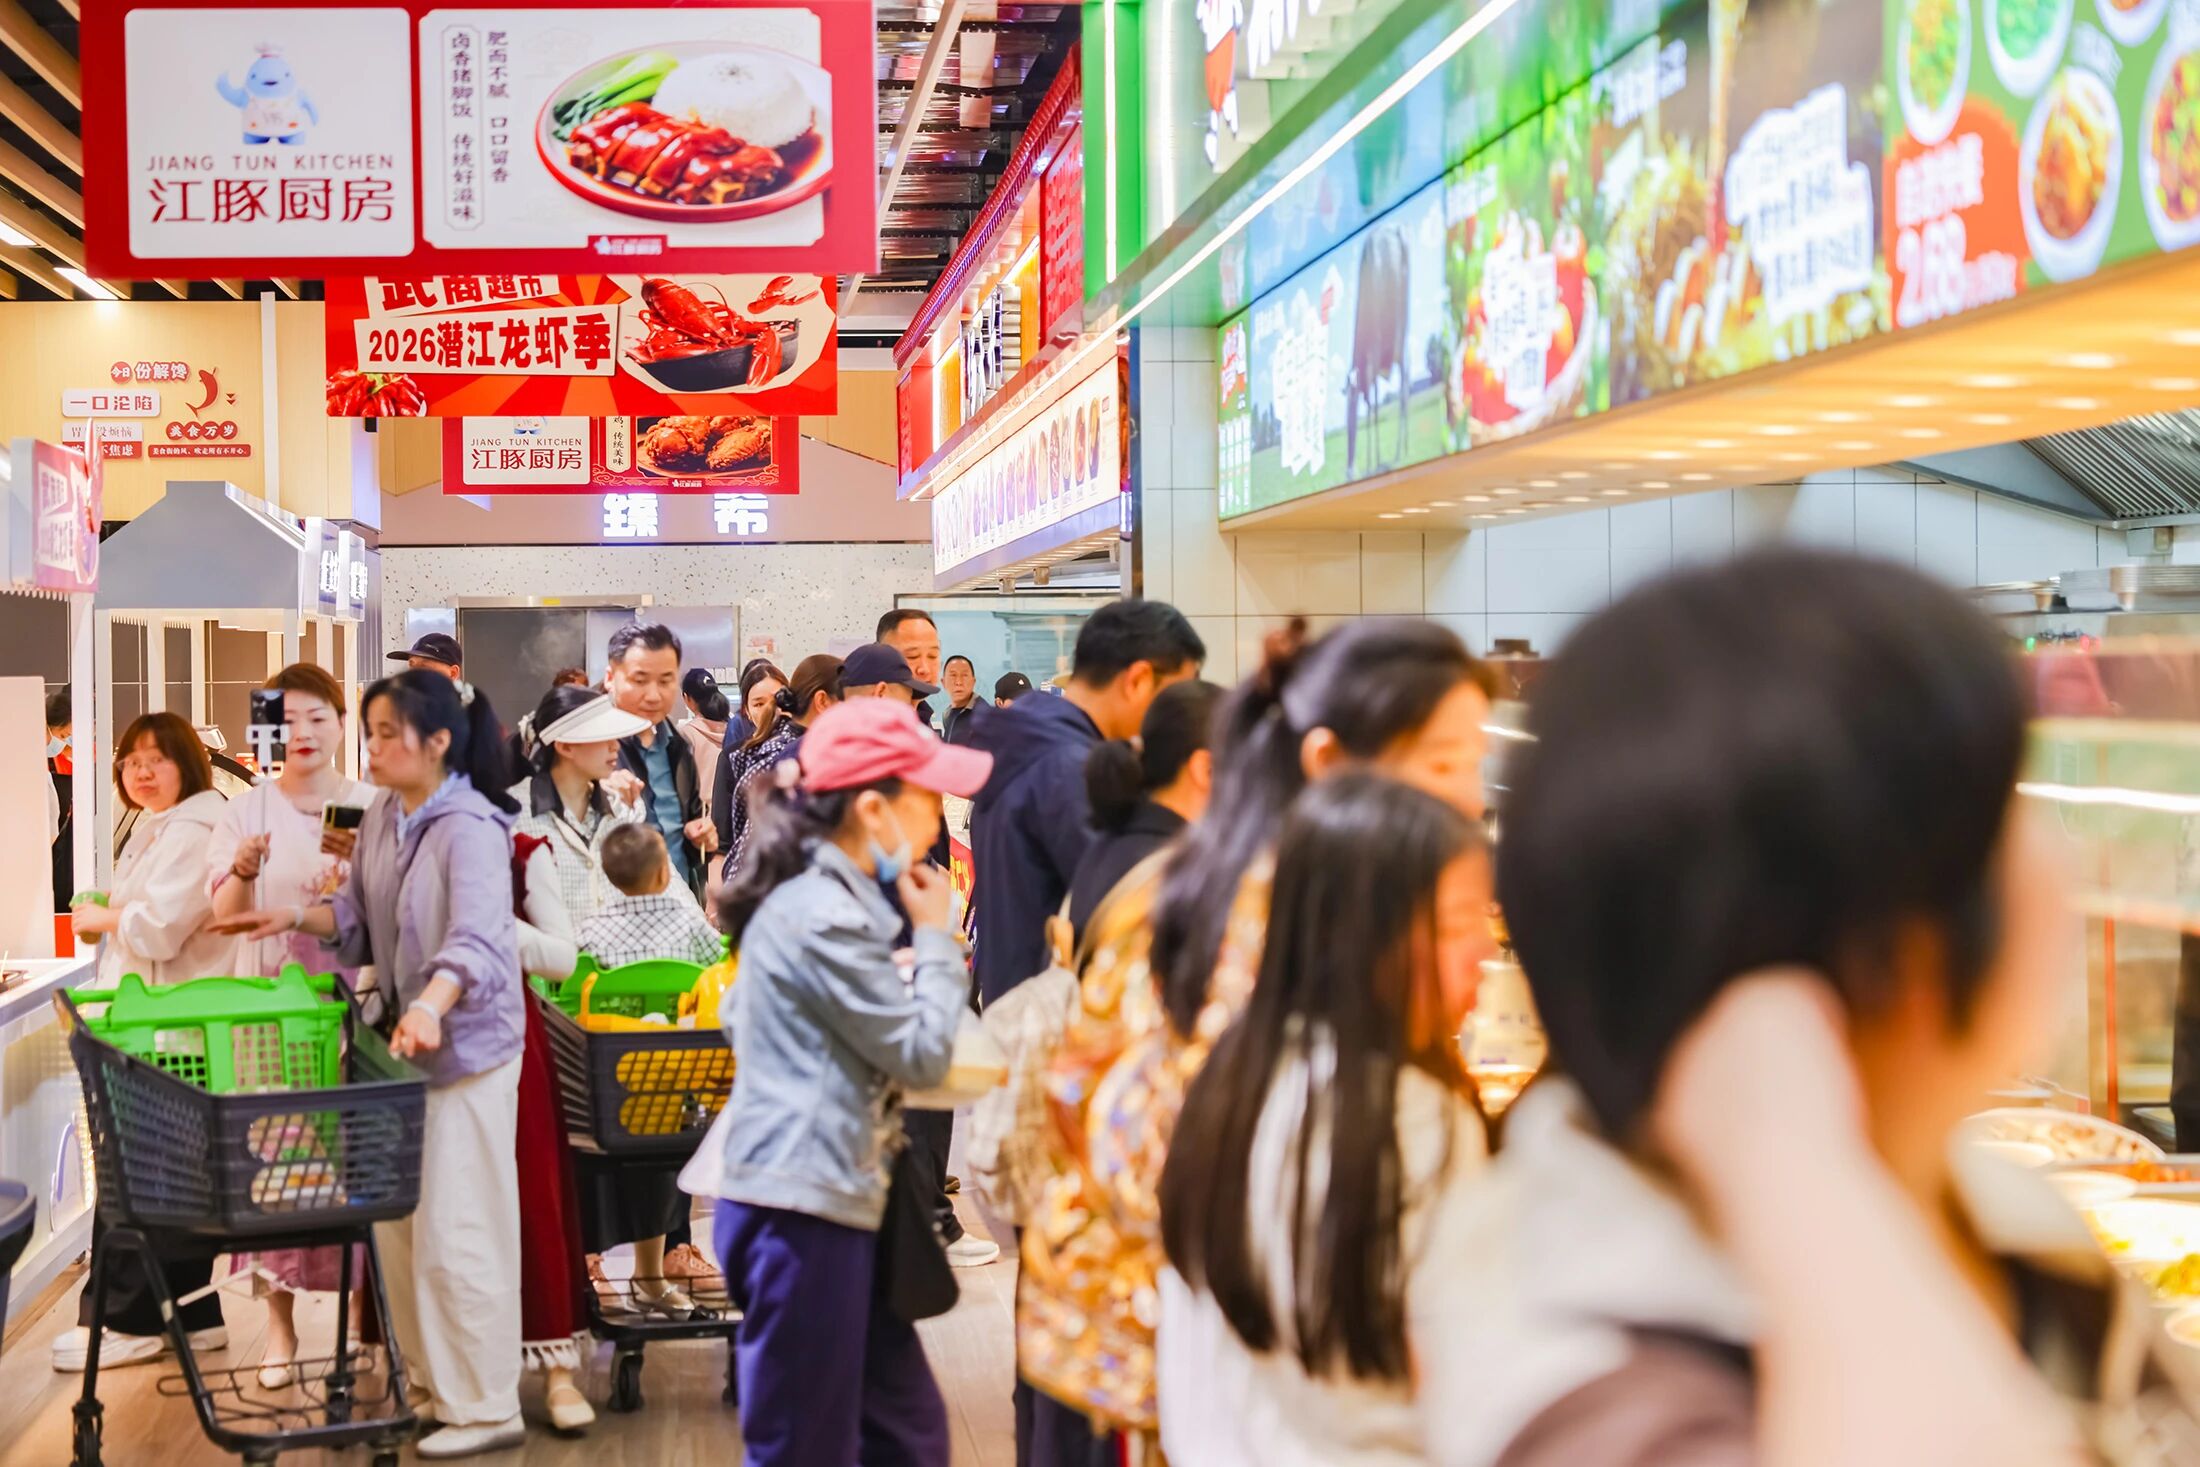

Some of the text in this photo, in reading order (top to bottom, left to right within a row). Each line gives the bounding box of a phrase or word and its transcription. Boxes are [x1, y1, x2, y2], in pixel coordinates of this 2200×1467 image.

[488, 31, 509, 183] 肥而不腻 口口留香
[452, 32, 475, 221] 卤香猪脚饭 传统好滋味
[146, 154, 394, 171] JIANG TUN KITCHEN
[148, 176, 395, 224] 江豚厨房
[369, 312, 611, 370] 2026潜江龙虾季
[70, 395, 153, 411] 一口沦陷
[169, 424, 236, 437] 美食万岁
[471, 438, 582, 446] JIANG TUN KITCHEN
[471, 447, 582, 470] 江豚厨房
